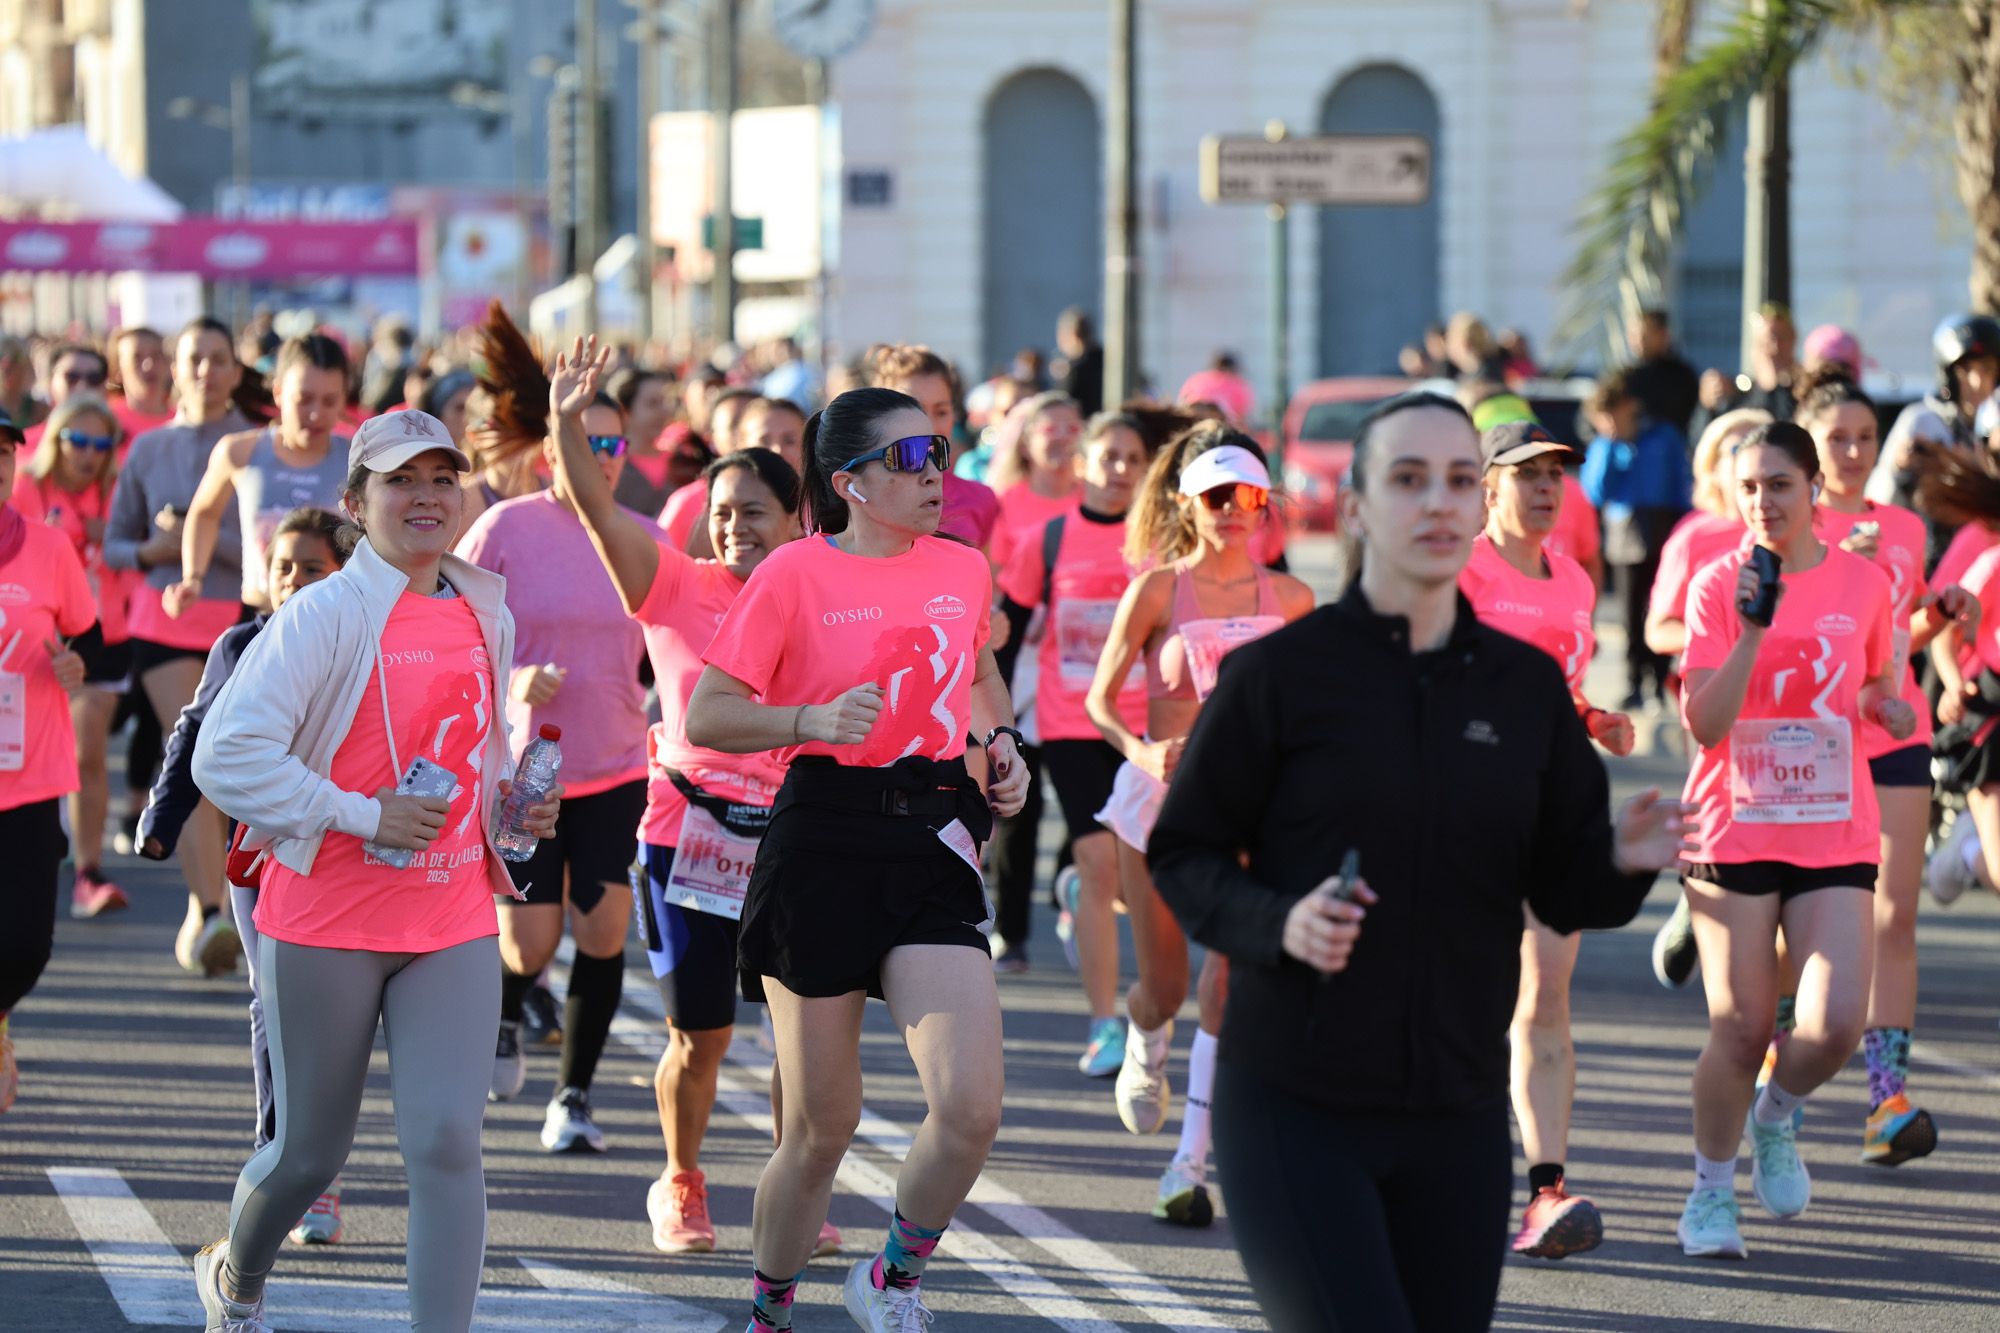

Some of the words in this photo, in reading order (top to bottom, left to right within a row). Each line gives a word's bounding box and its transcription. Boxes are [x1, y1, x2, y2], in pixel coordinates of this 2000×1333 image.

[823, 606, 883, 626] OYSHO
[1773, 764, 1816, 782] 016
[429, 852, 447, 868] DE
[426, 870, 450, 883] 2025
